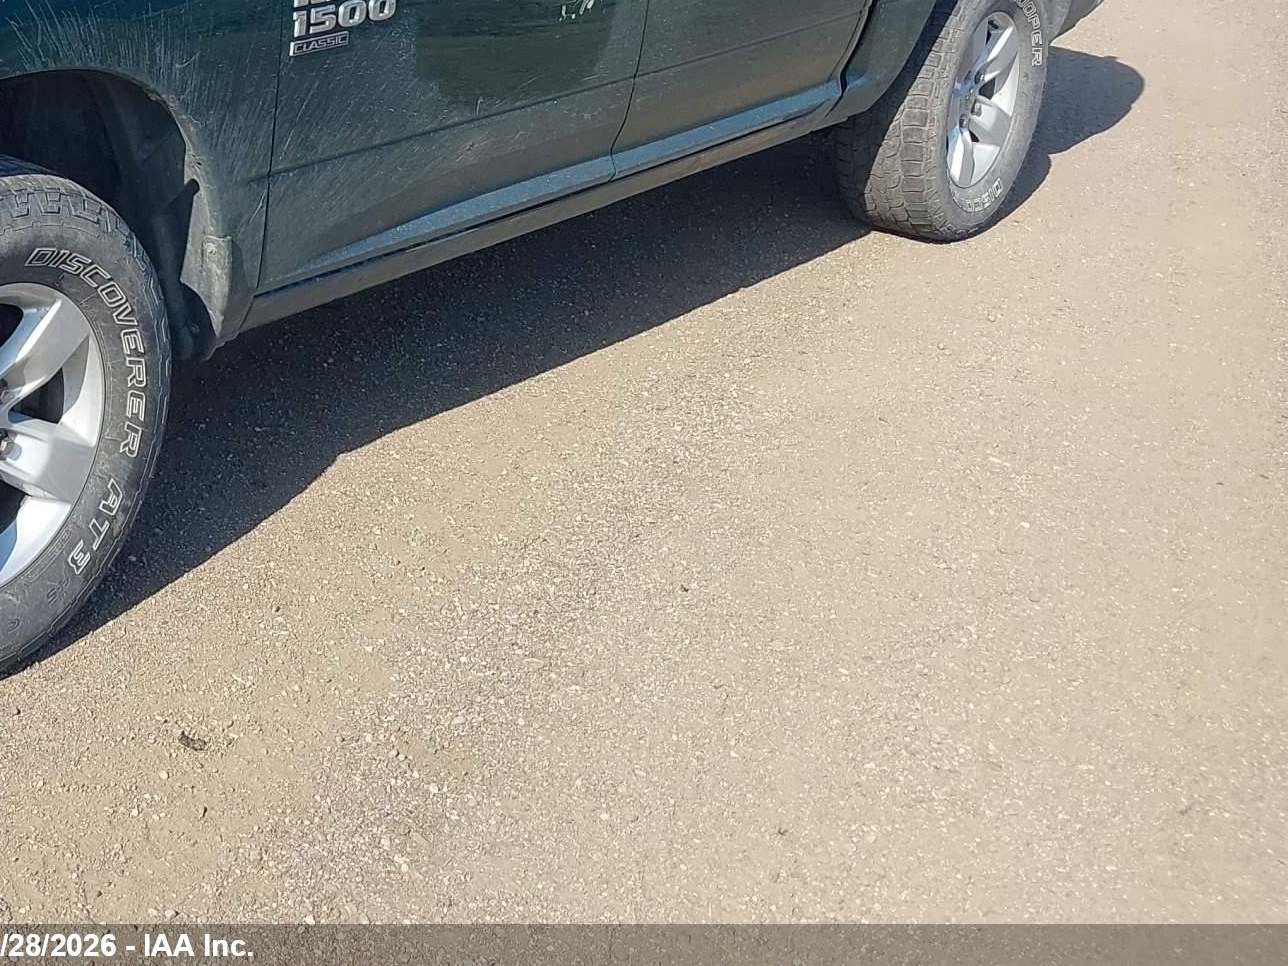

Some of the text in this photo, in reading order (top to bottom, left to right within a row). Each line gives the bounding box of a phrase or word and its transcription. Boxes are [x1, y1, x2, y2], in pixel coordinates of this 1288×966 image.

[292, 33, 348, 54] CLASSIC
[24, 247, 147, 458] DISCOVERER
[67, 477, 123, 575] AT3
